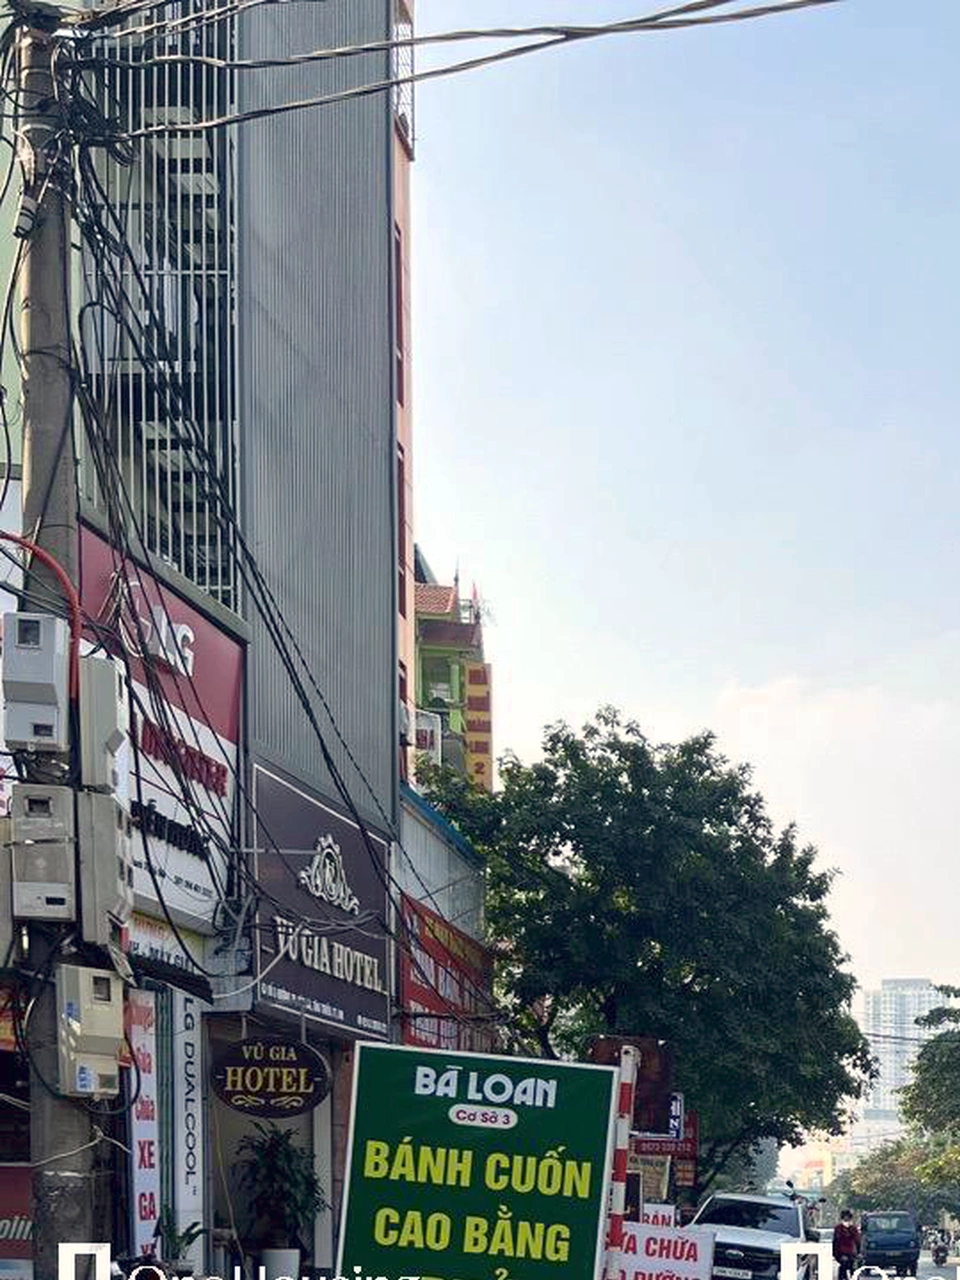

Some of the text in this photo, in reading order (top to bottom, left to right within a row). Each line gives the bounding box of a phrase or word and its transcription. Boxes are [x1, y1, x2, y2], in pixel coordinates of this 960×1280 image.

[332, 942, 382, 992] HOTEL
[184, 997, 195, 1031] LG
[270, 1046, 297, 1060] GIA
[224, 1066, 314, 1093] HOTEL
[467, 1072, 557, 1108] LOAN
[503, 1114, 510, 1125] 3
[138, 1140, 155, 1169] XE
[363, 1136, 591, 1198] BÁNH CUỐN
[138, 1192, 156, 1221] GA
[374, 1207, 451, 1251] CAO
[463, 1204, 570, 1262] BẰNG
[645, 1235, 698, 1262] CHỮA
